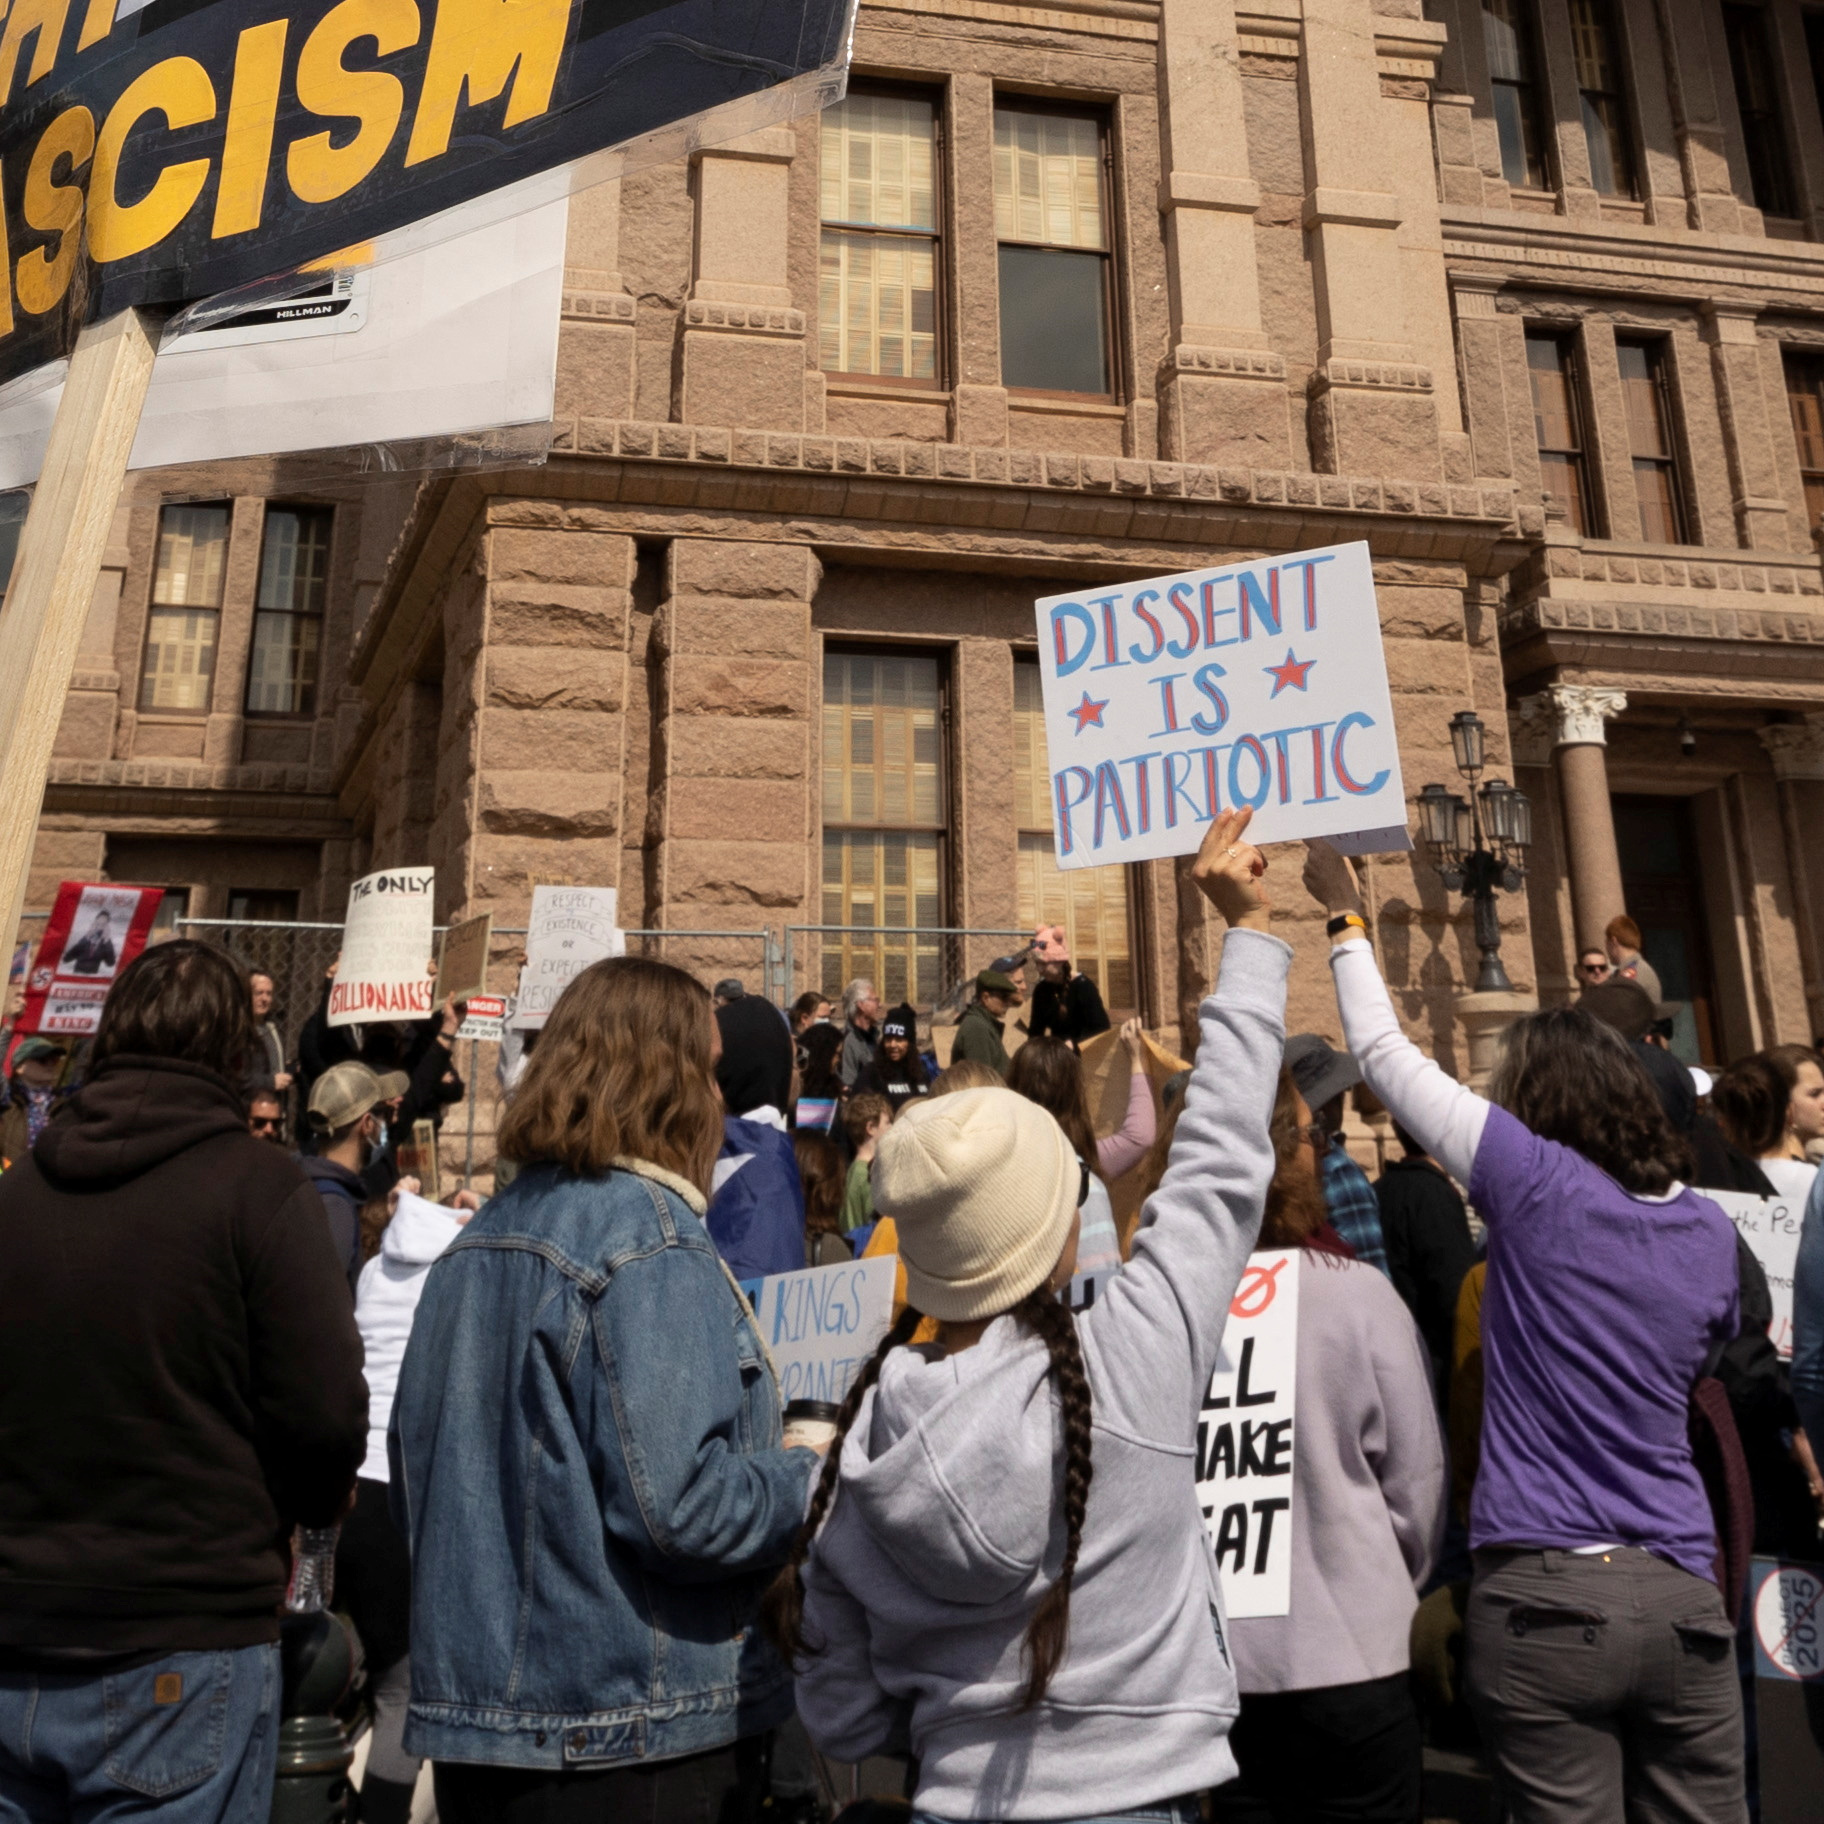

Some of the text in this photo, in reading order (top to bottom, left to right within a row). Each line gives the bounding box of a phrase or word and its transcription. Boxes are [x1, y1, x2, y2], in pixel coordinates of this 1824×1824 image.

[277, 305, 332, 319] HILLMAN
[1050, 555, 1335, 678] DISSENT
[1148, 662, 1230, 739] IS
[1054, 711, 1391, 856] PATRIOTIC
[353, 875, 433, 902] THE ONLY
[551, 894, 595, 910] RESPECT
[546, 918, 600, 935] EXISTENCE
[562, 940, 575, 948] OR
[331, 980, 433, 1016] BILLIONAIRES
[884, 1024, 905, 1035] NYC
[772, 1269, 866, 1346] KINGS
[1791, 1577, 1819, 1668] 2025
